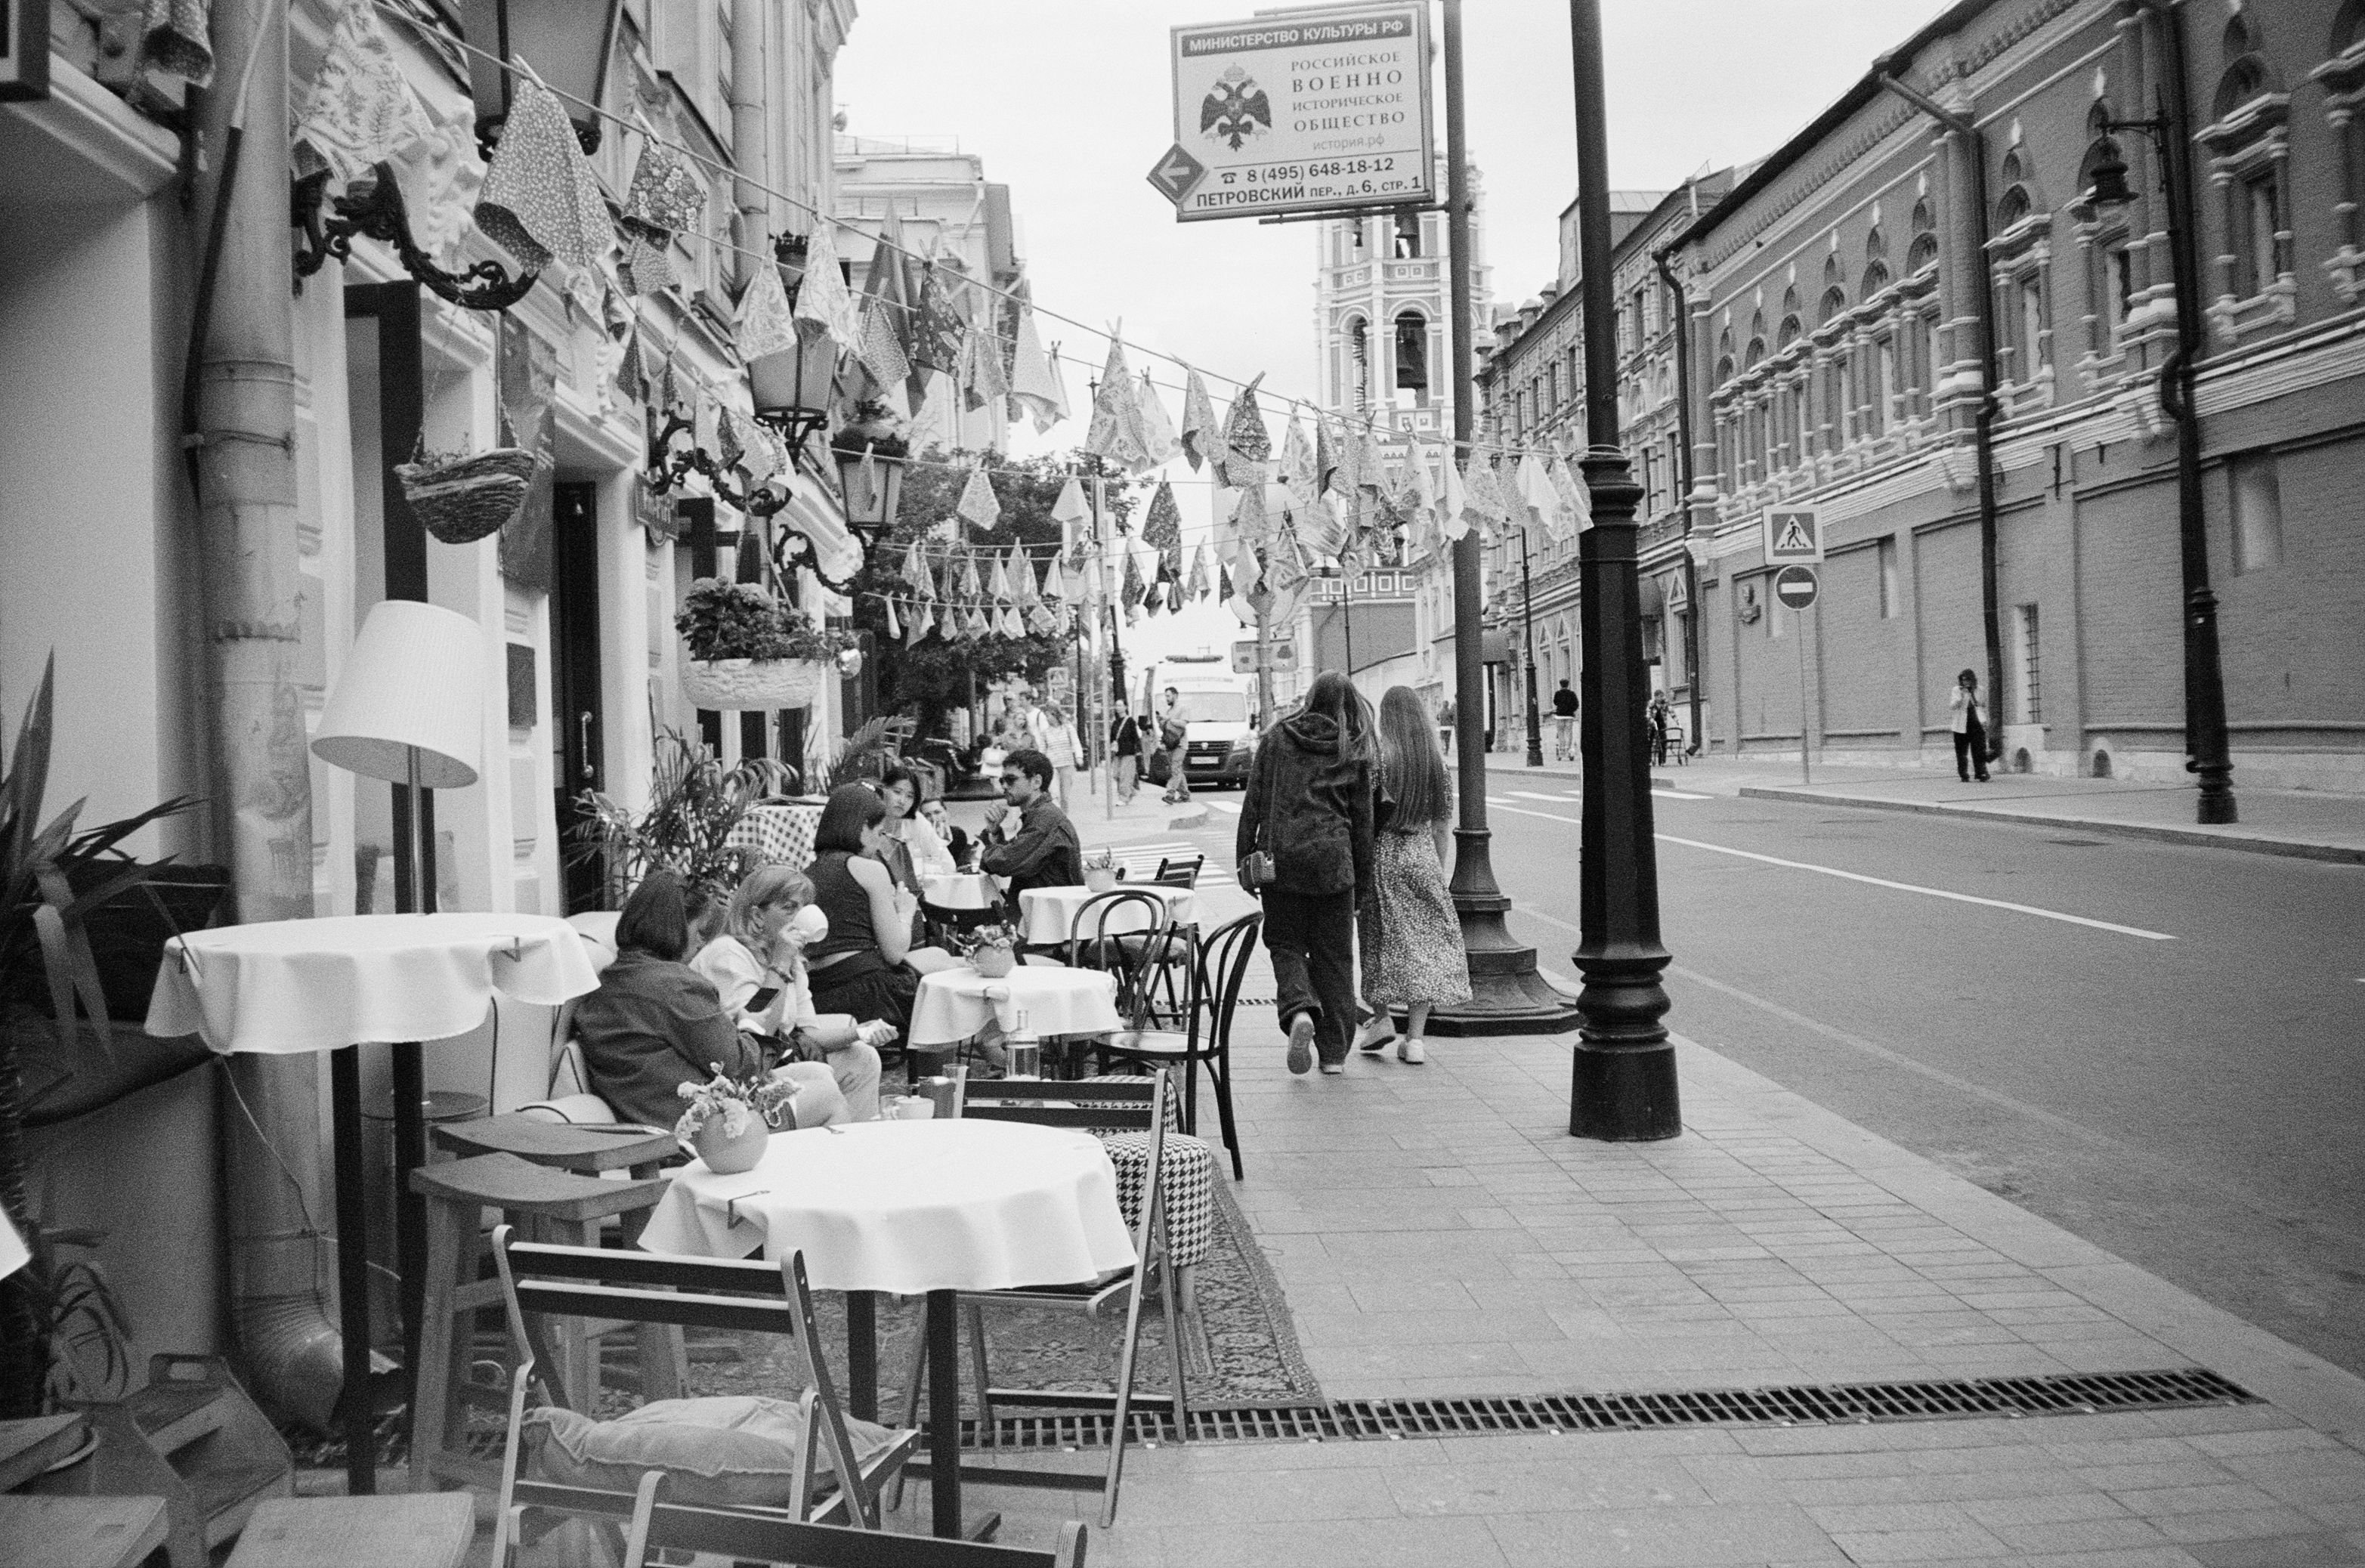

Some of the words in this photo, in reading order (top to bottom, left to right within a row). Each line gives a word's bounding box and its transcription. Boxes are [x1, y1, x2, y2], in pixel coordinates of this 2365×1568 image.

[1189, 29, 1299, 51] МИНИСТЕРСТВО
[1303, 23, 1377, 40] КУЛЬТУРЫ
[1382, 20, 1403, 34] РФ
[1291, 51, 1400, 72] РОССИЙСКОЕ
[1293, 70, 1402, 92] ВОЕННО
[1293, 93, 1403, 112] ИСТОРИЧЕСКОЕ
[1294, 111, 1405, 131] ОБЩЕСТВО
[1313, 133, 1384, 150] история.рф
[1247, 169, 1257, 182] 8
[1262, 165, 1304, 184] (495)
[1309, 157, 1394, 177] 648-18-12
[1197, 181, 1304, 207] ПЕТРОВСКИЙ
[1362, 180, 1377, 194] 6,
[1411, 176, 1421, 189] 1
